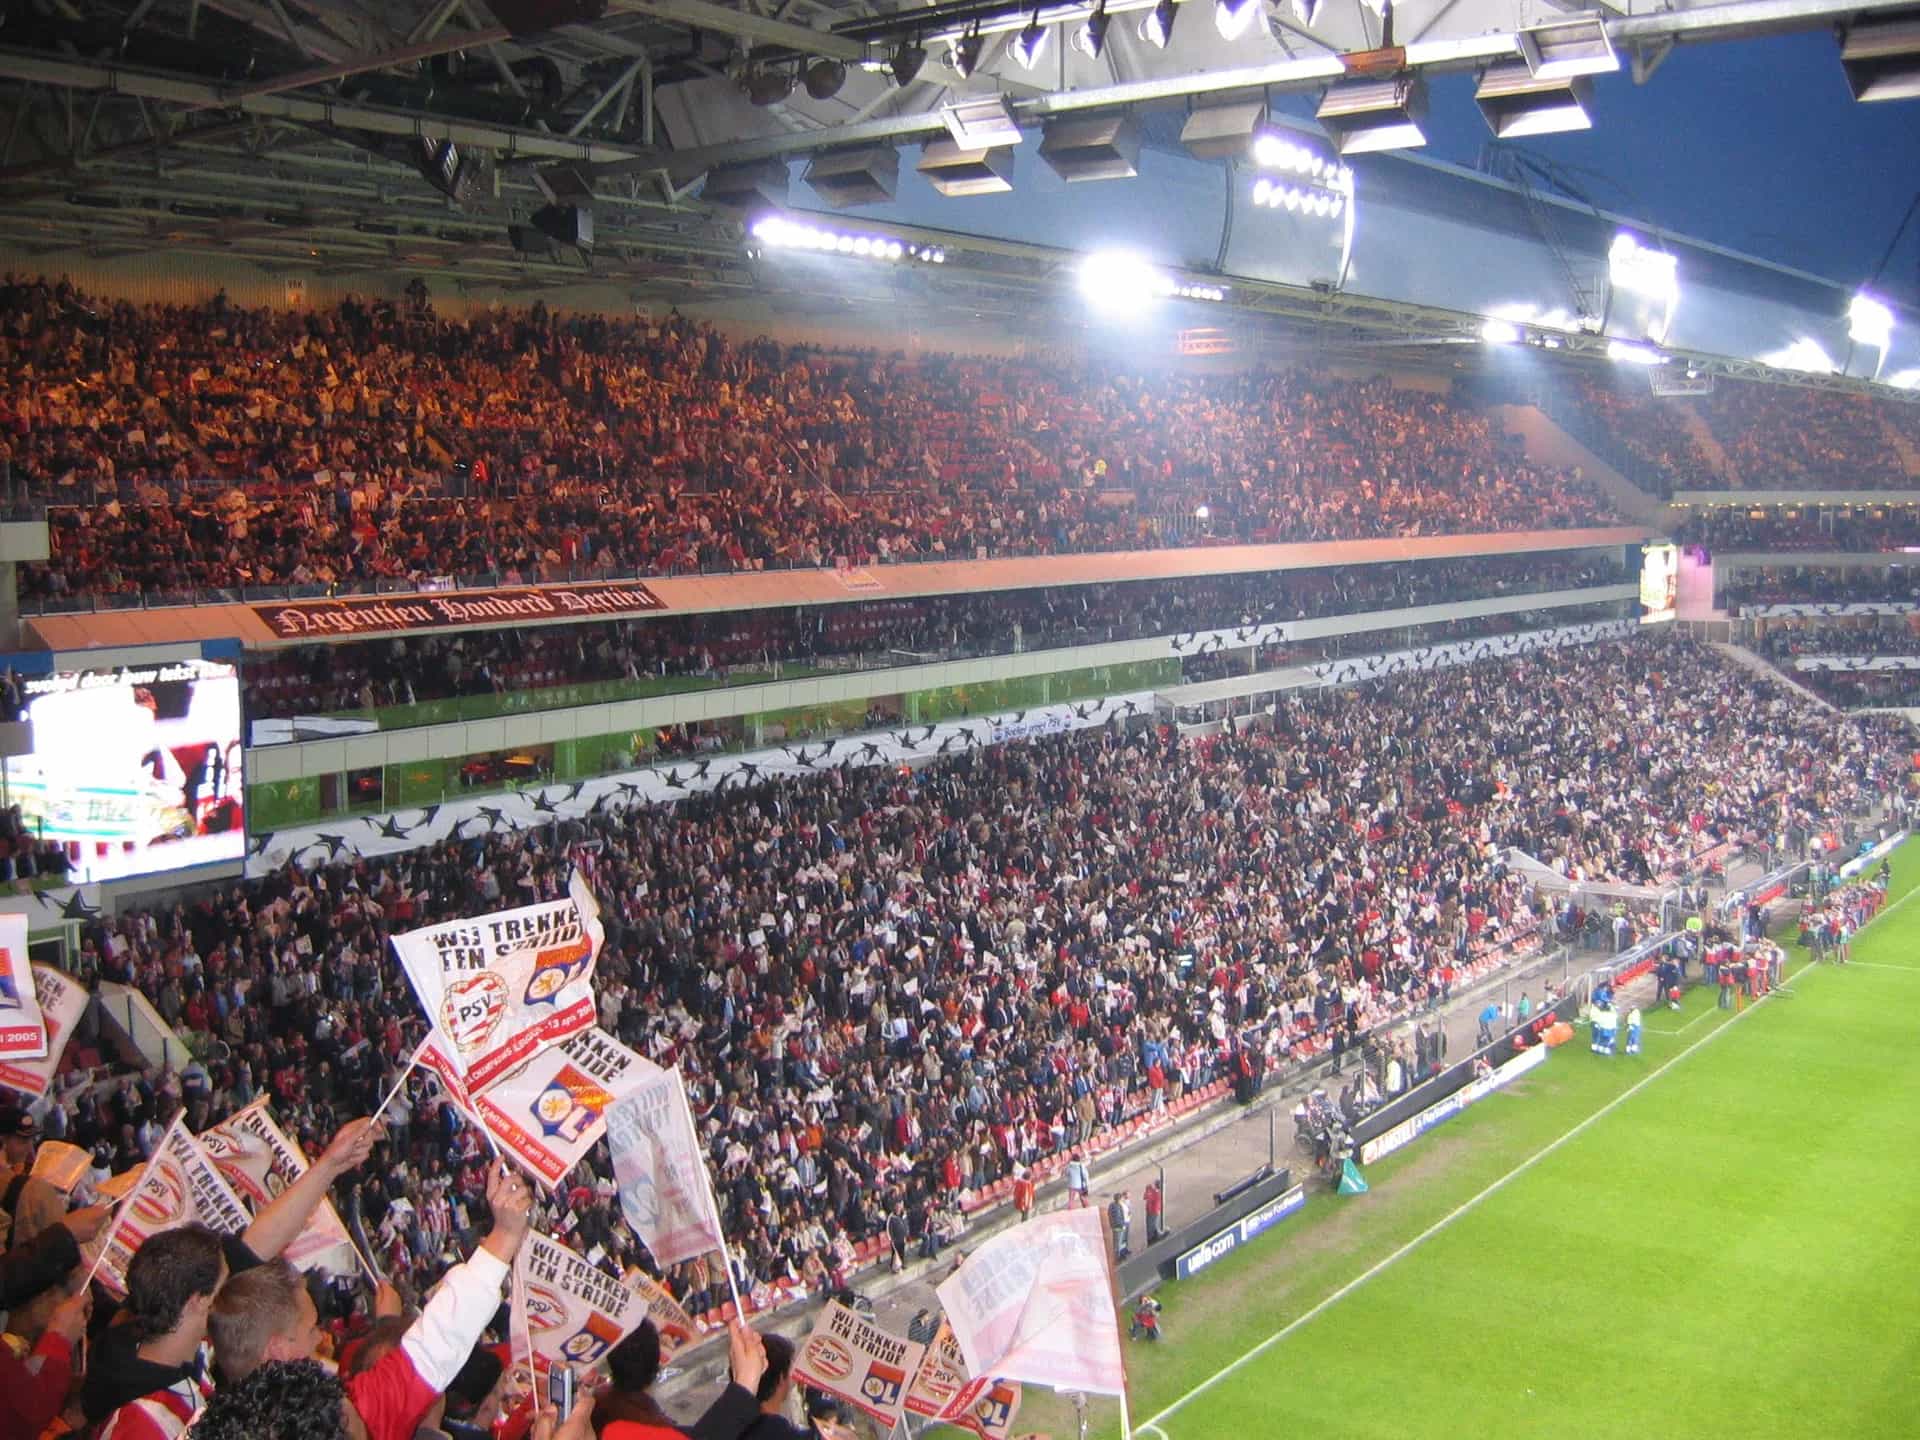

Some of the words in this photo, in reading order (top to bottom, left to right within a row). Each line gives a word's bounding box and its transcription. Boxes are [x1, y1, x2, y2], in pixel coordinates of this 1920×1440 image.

[274, 602, 433, 633] Negentien
[430, 590, 548, 623] Honderd
[559, 586, 656, 613] Dertien
[160, 663, 196, 681] tekst
[488, 905, 580, 943] TREKKE
[438, 948, 486, 972] TEN
[458, 993, 492, 1022] PSV
[7, 1032, 38, 1043] 2005
[202, 1134, 228, 1154] PSV
[144, 1176, 170, 1198] PSV
[191, 1161, 244, 1229] TREKKE
[528, 1255, 558, 1283] TEN
[565, 1256, 631, 1304] TREKKEN
[526, 1298, 553, 1314] PSV
[829, 1319, 852, 1339] TEN
[855, 1322, 908, 1356] TREKKEN
[820, 1347, 839, 1363] PSV
[934, 1369, 955, 1383] PSV
